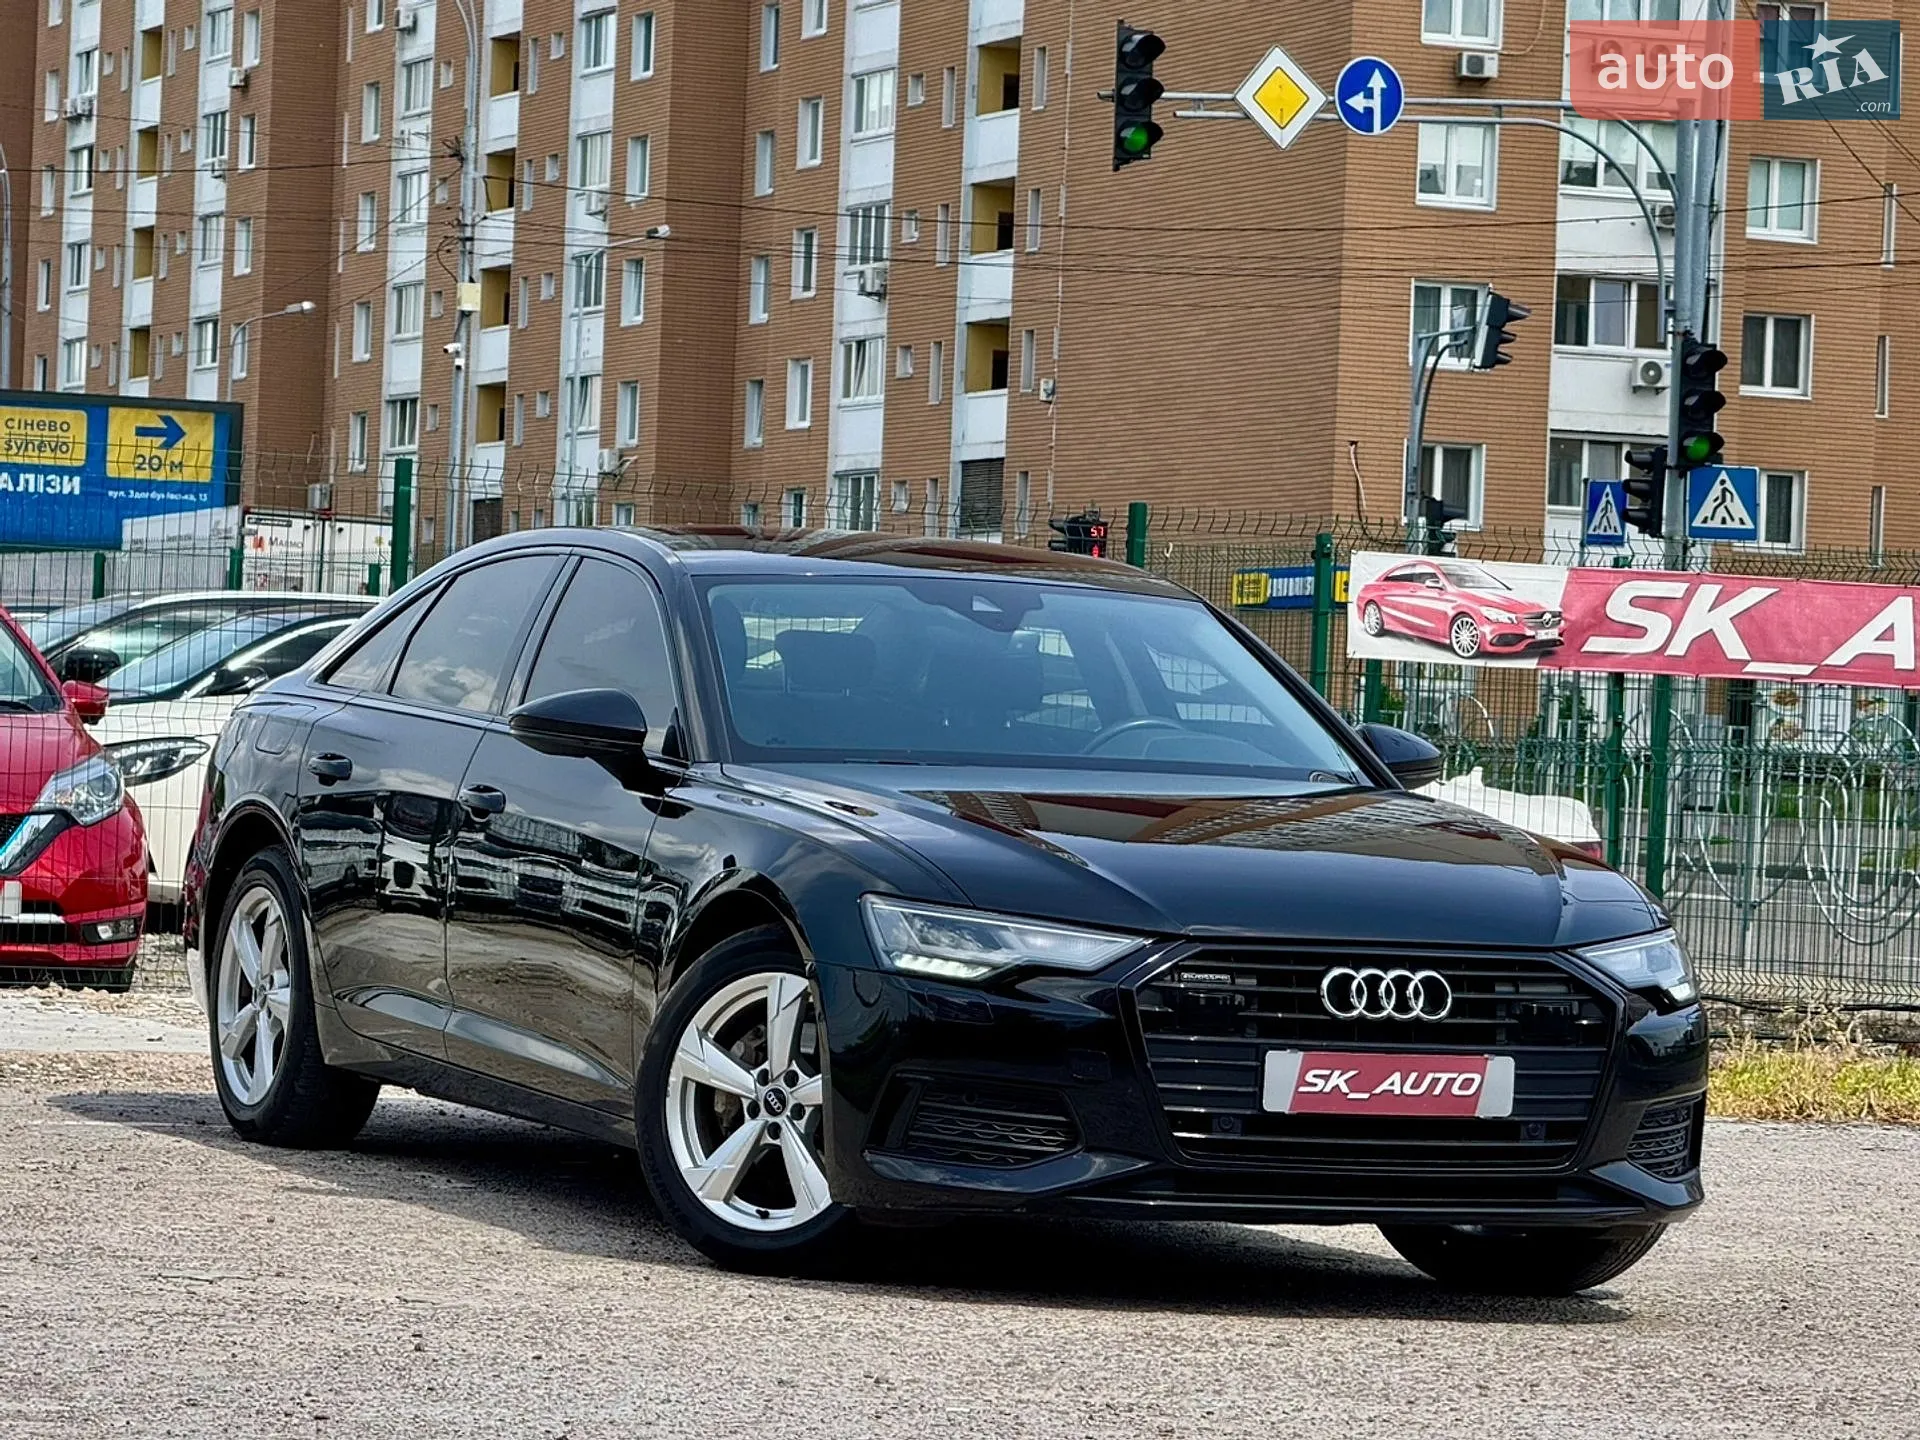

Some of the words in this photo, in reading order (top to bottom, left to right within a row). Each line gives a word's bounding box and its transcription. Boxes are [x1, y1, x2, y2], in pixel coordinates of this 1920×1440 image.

[135, 454, 163, 472] 20
[1090, 525, 1104, 537] 57
[1297, 1068, 1483, 1100] SK_AUTO
